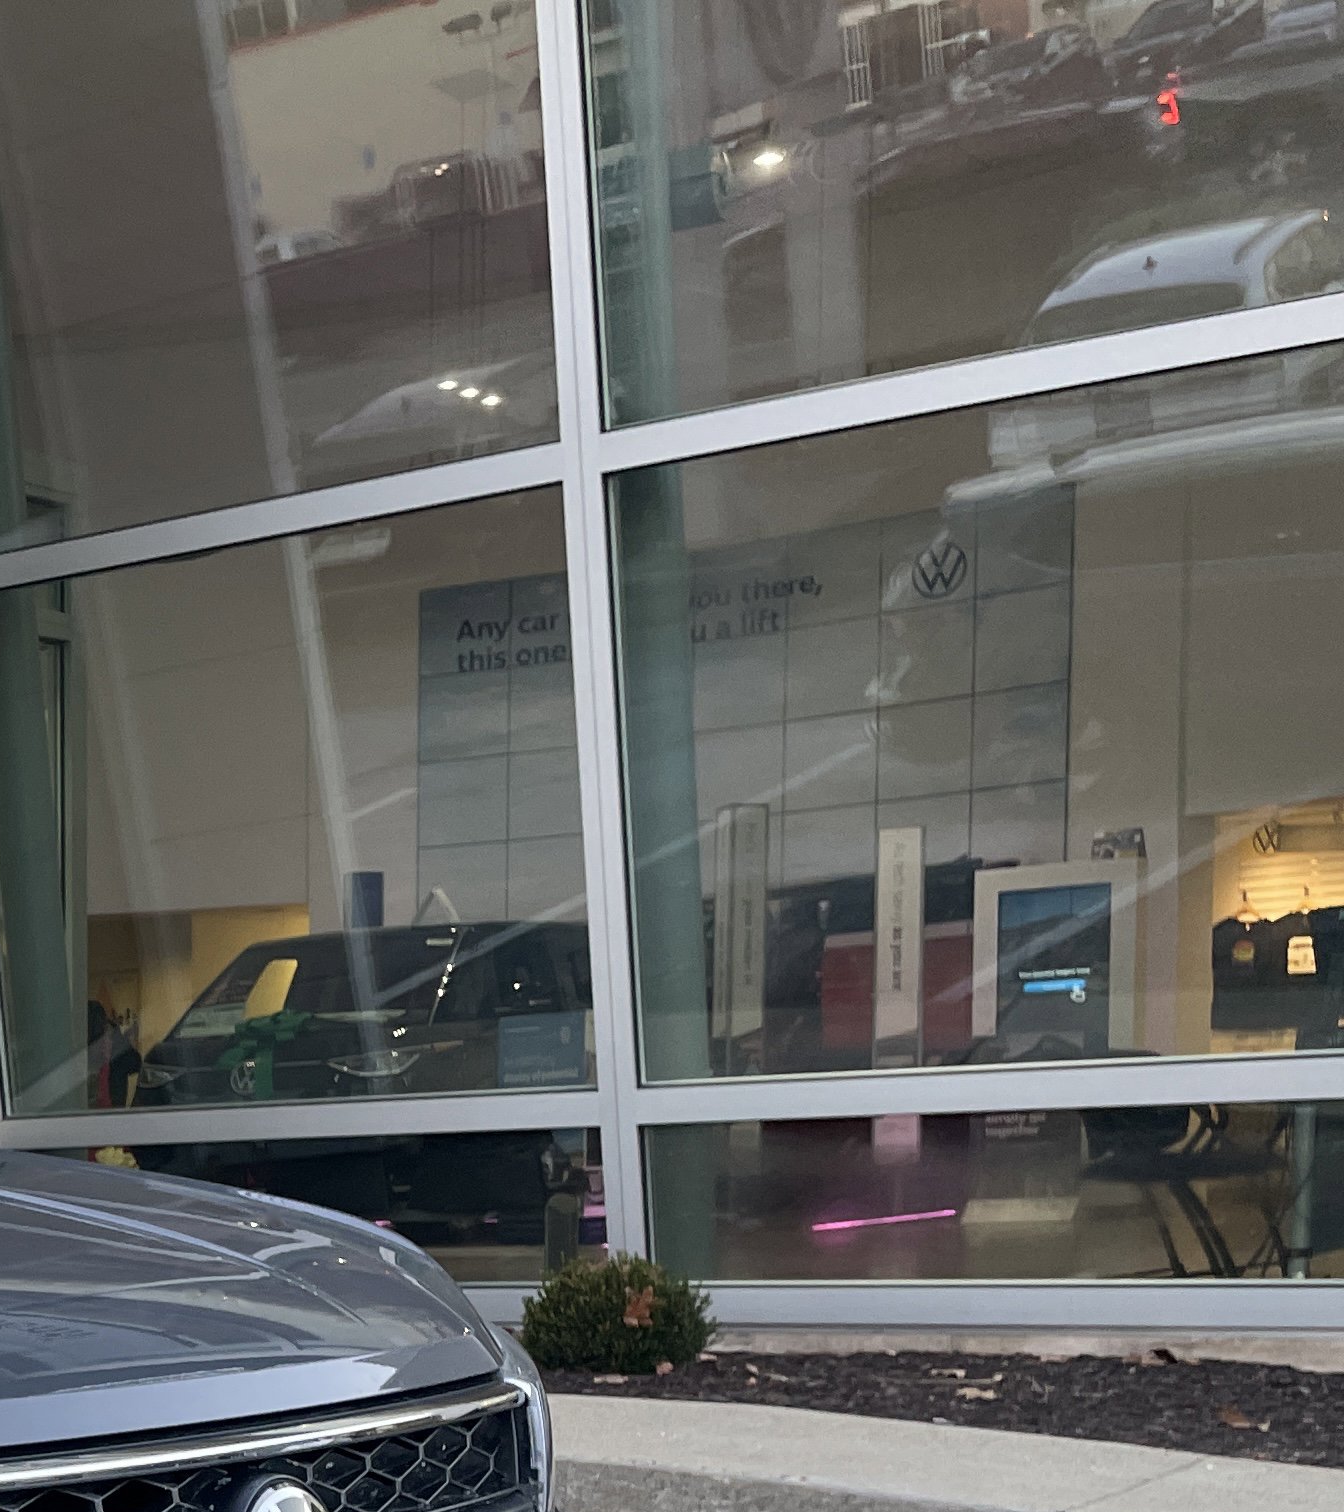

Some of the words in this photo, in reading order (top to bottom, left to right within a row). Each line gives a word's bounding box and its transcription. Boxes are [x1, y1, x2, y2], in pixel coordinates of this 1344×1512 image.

[457, 618, 511, 643] Any
[518, 613, 560, 634] car
[458, 645, 507, 673] this
